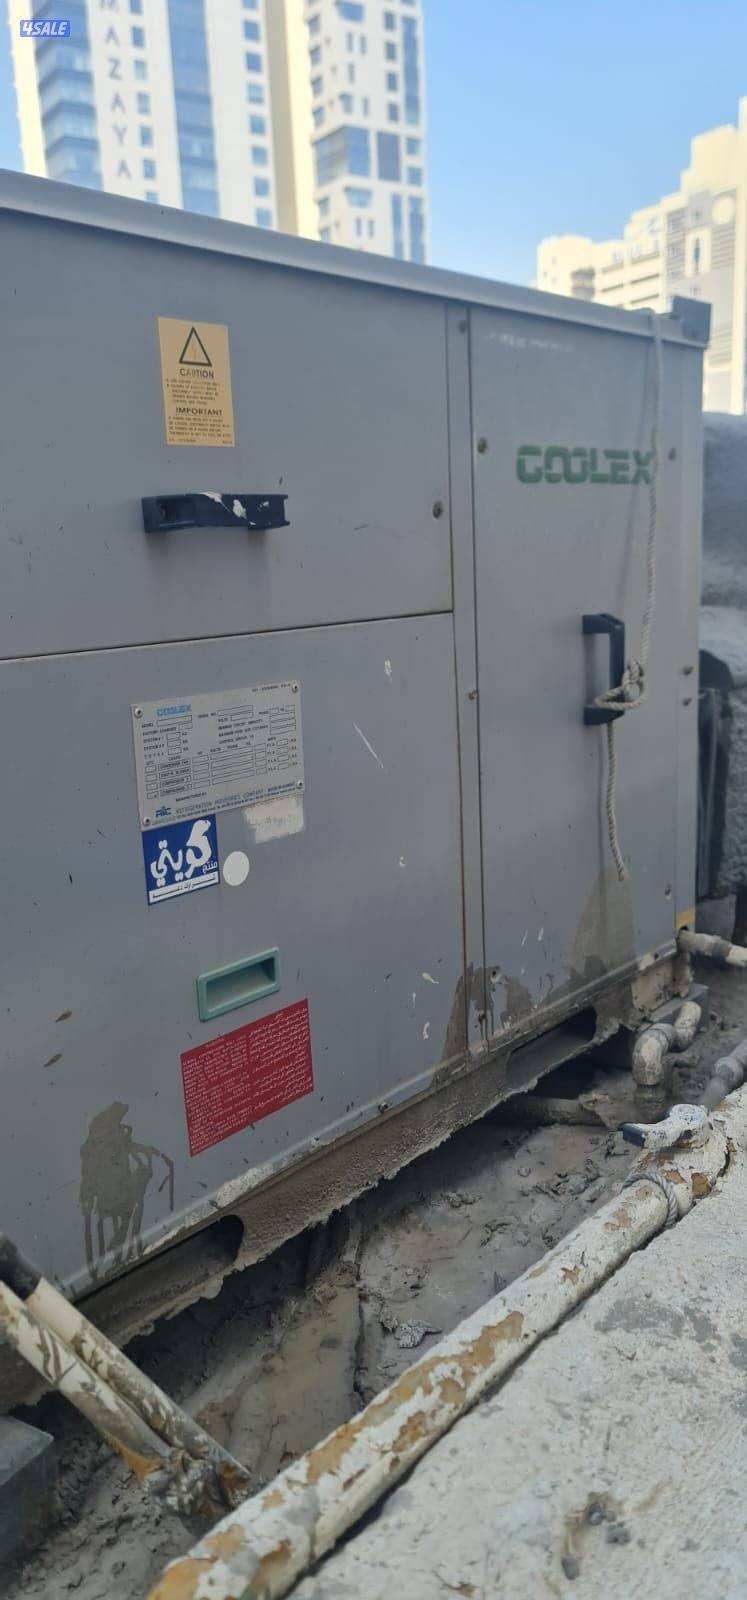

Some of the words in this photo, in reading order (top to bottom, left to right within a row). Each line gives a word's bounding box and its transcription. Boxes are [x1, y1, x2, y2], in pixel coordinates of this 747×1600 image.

[179, 368, 214, 379] CAUTION
[175, 407, 223, 416] IMPORTANT
[516, 445, 652, 485] COOLEX
[150, 819, 212, 887] كويتي
